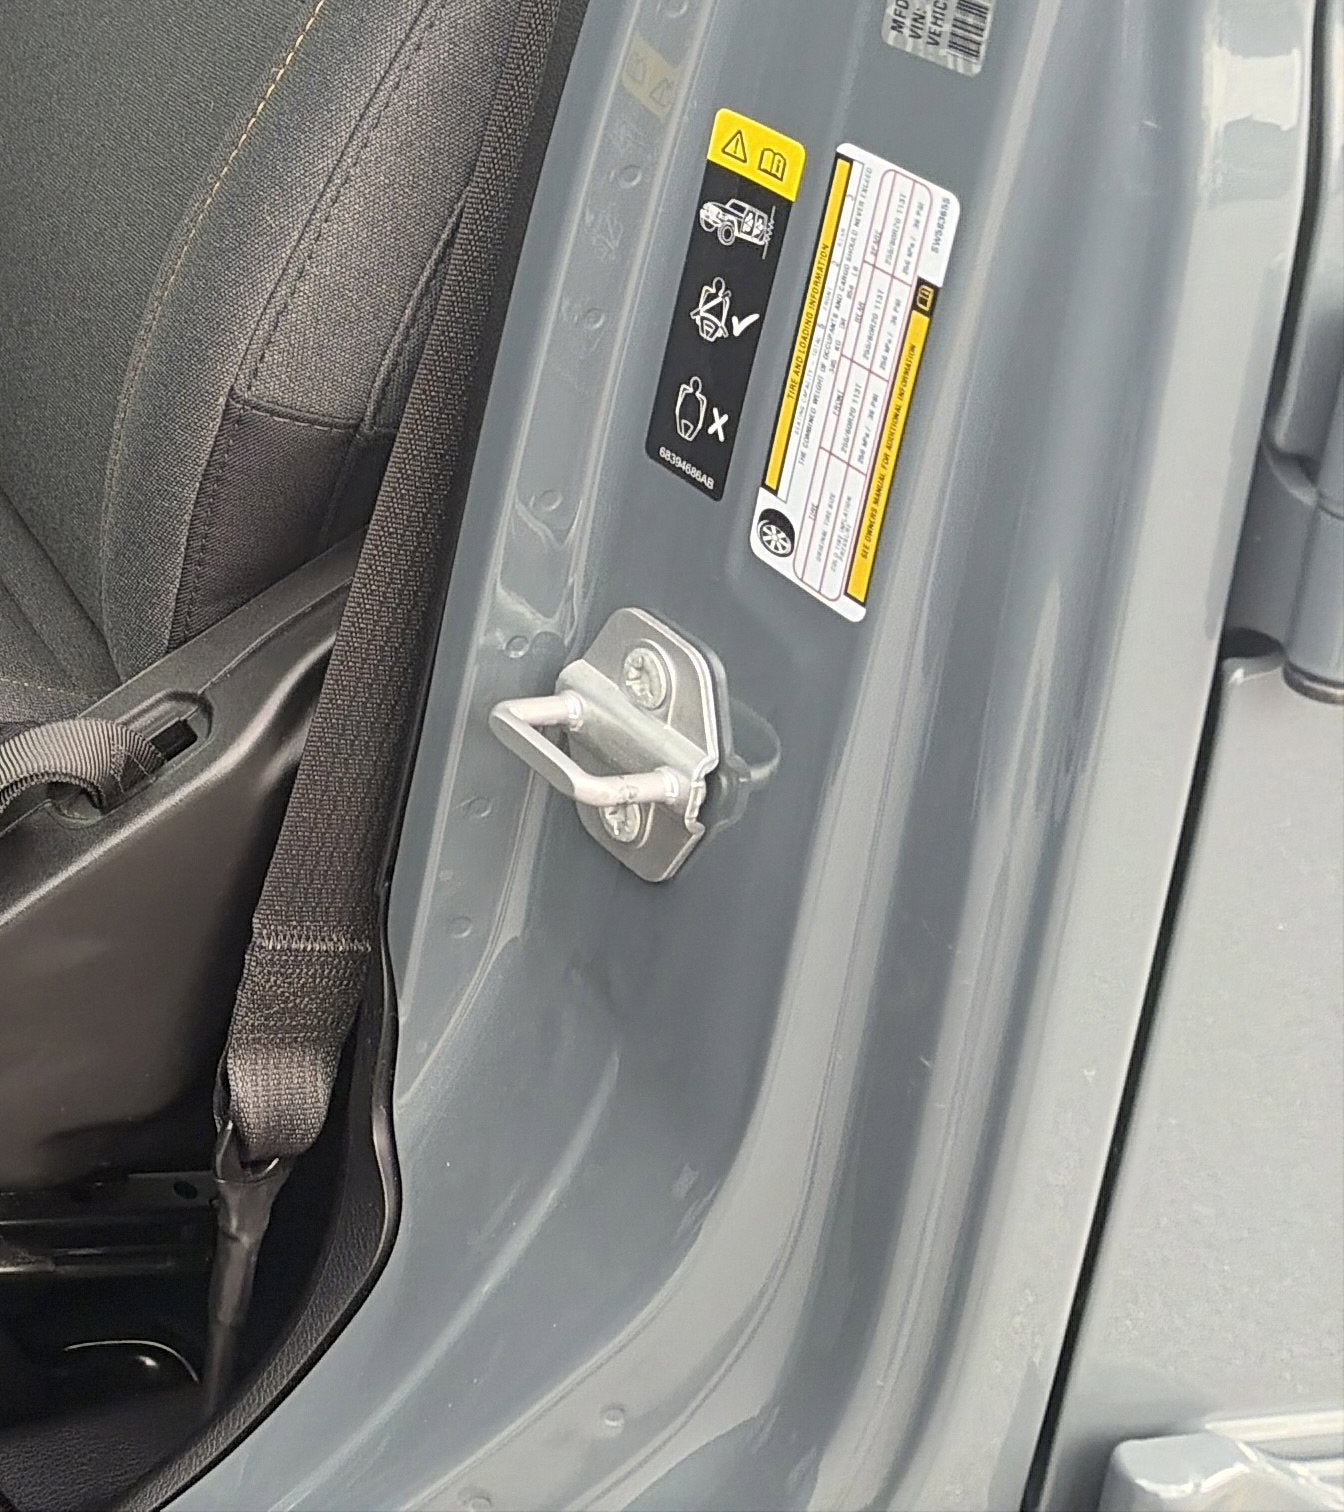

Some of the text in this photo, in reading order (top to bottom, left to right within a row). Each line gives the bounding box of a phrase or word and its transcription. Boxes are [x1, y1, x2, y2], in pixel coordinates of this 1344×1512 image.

[908, 6, 927, 41] VIN:
[838, 262, 850, 292] CARGO
[834, 292, 843, 311] AND
[786, 241, 829, 400] TIRE AND LOADING INFORMATION
[896, 342, 918, 403] INFORMATION
[884, 401, 903, 452] ADDITIONAL
[659, 446, 715, 490] 68394686AB
[880, 450, 891, 471] FOR
[871, 470, 887, 507] MANUAL
[859, 542, 870, 560] SEE
